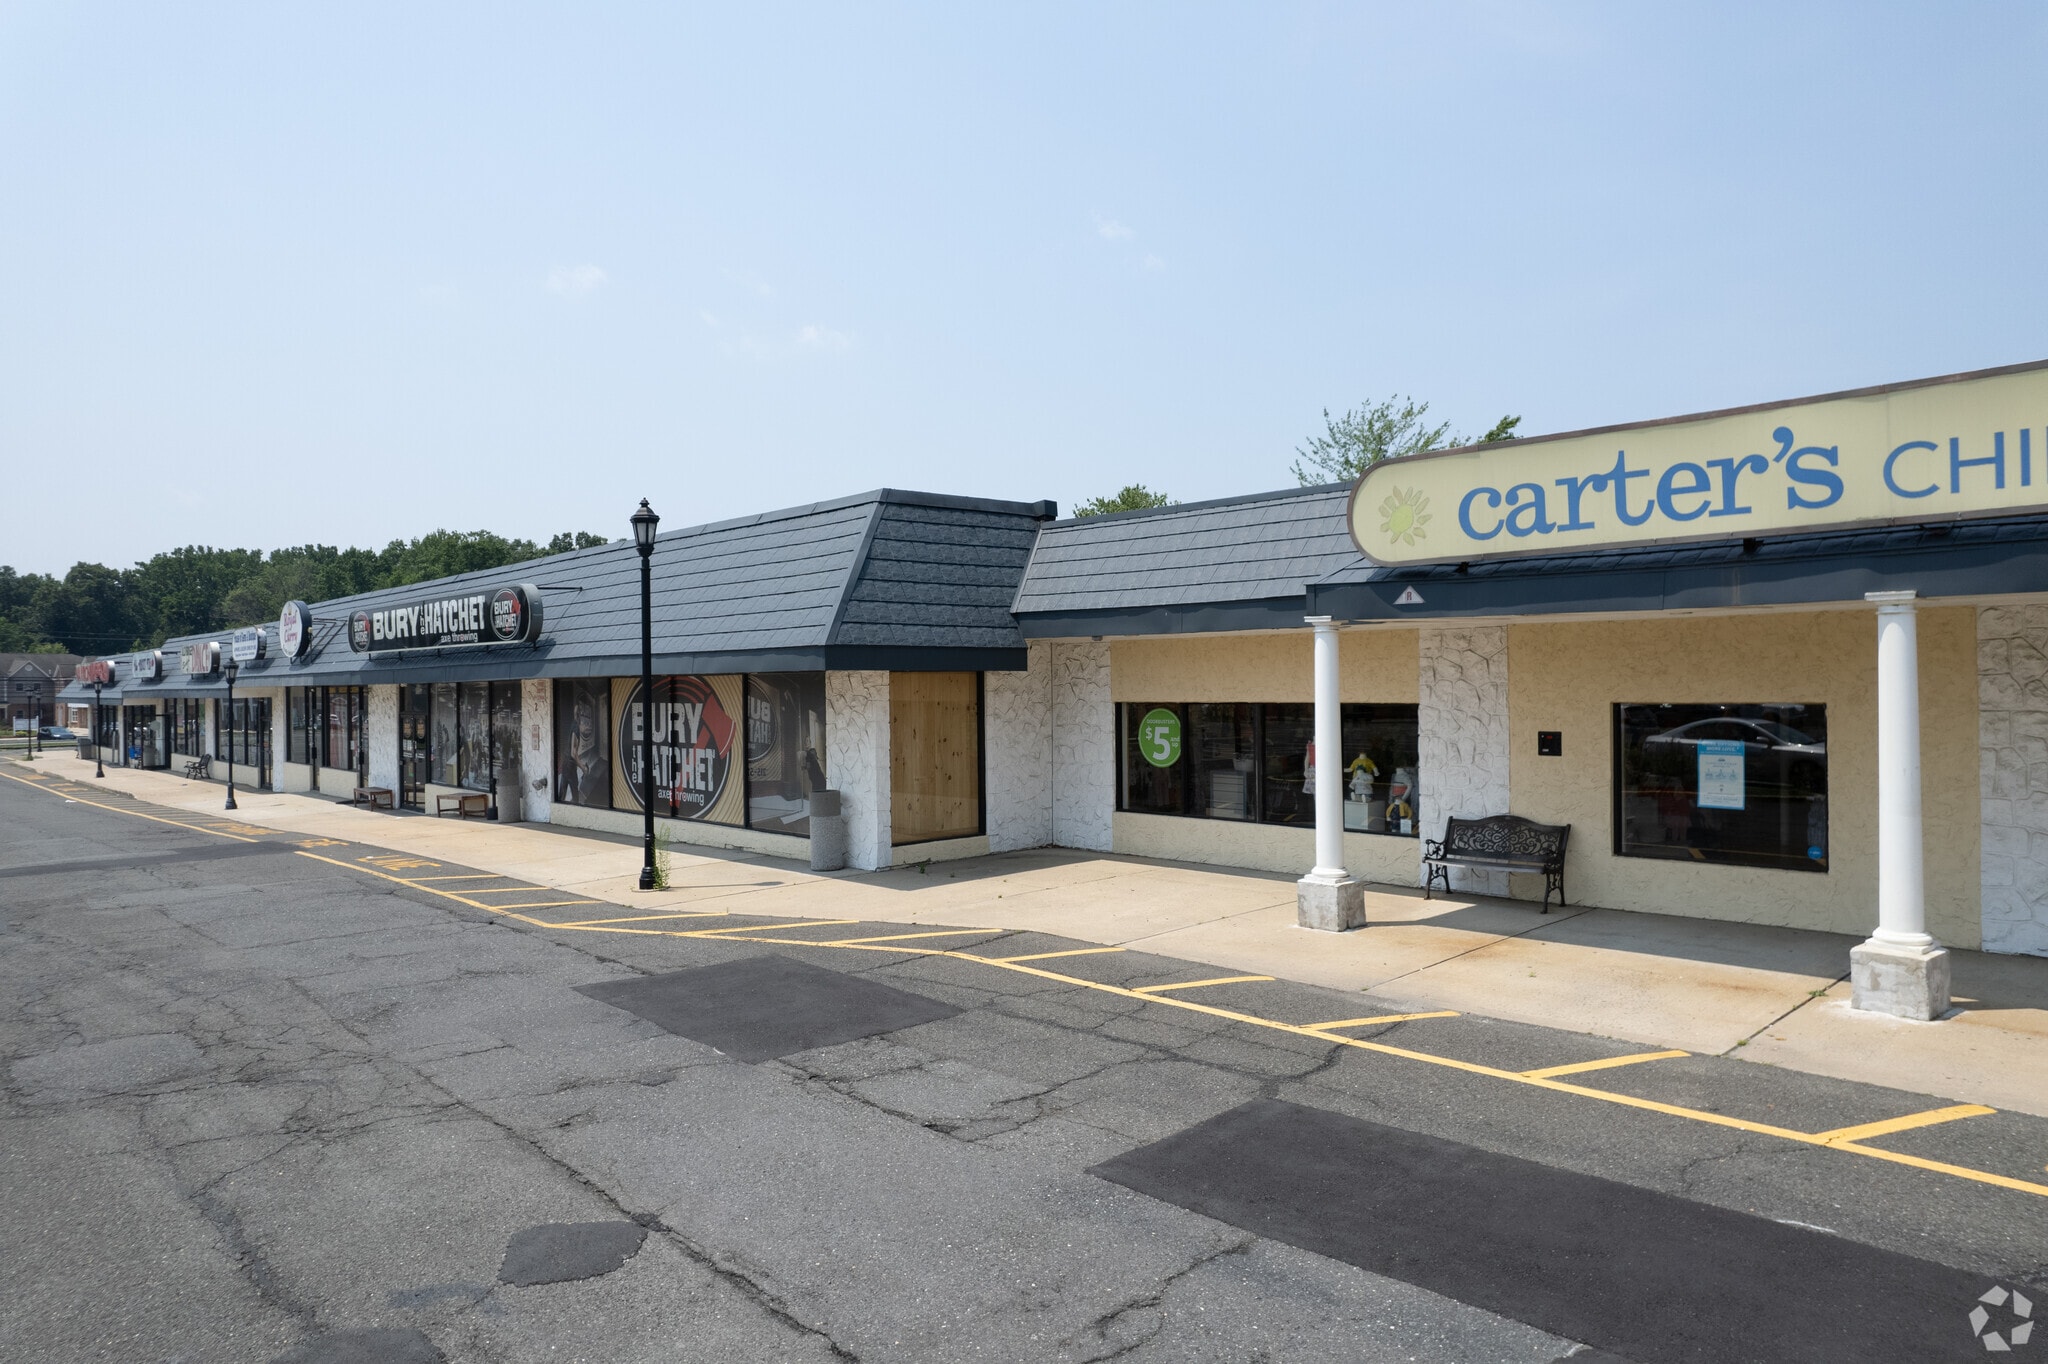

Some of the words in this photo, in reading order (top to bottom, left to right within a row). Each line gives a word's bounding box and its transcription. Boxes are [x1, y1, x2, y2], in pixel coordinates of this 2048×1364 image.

[1458, 427, 1844, 541] carter's
[1883, 427, 2048, 499] CHI
[372, 605, 421, 641] BURY
[425, 595, 486, 634] HATCHET
[493, 600, 514, 614] BURY
